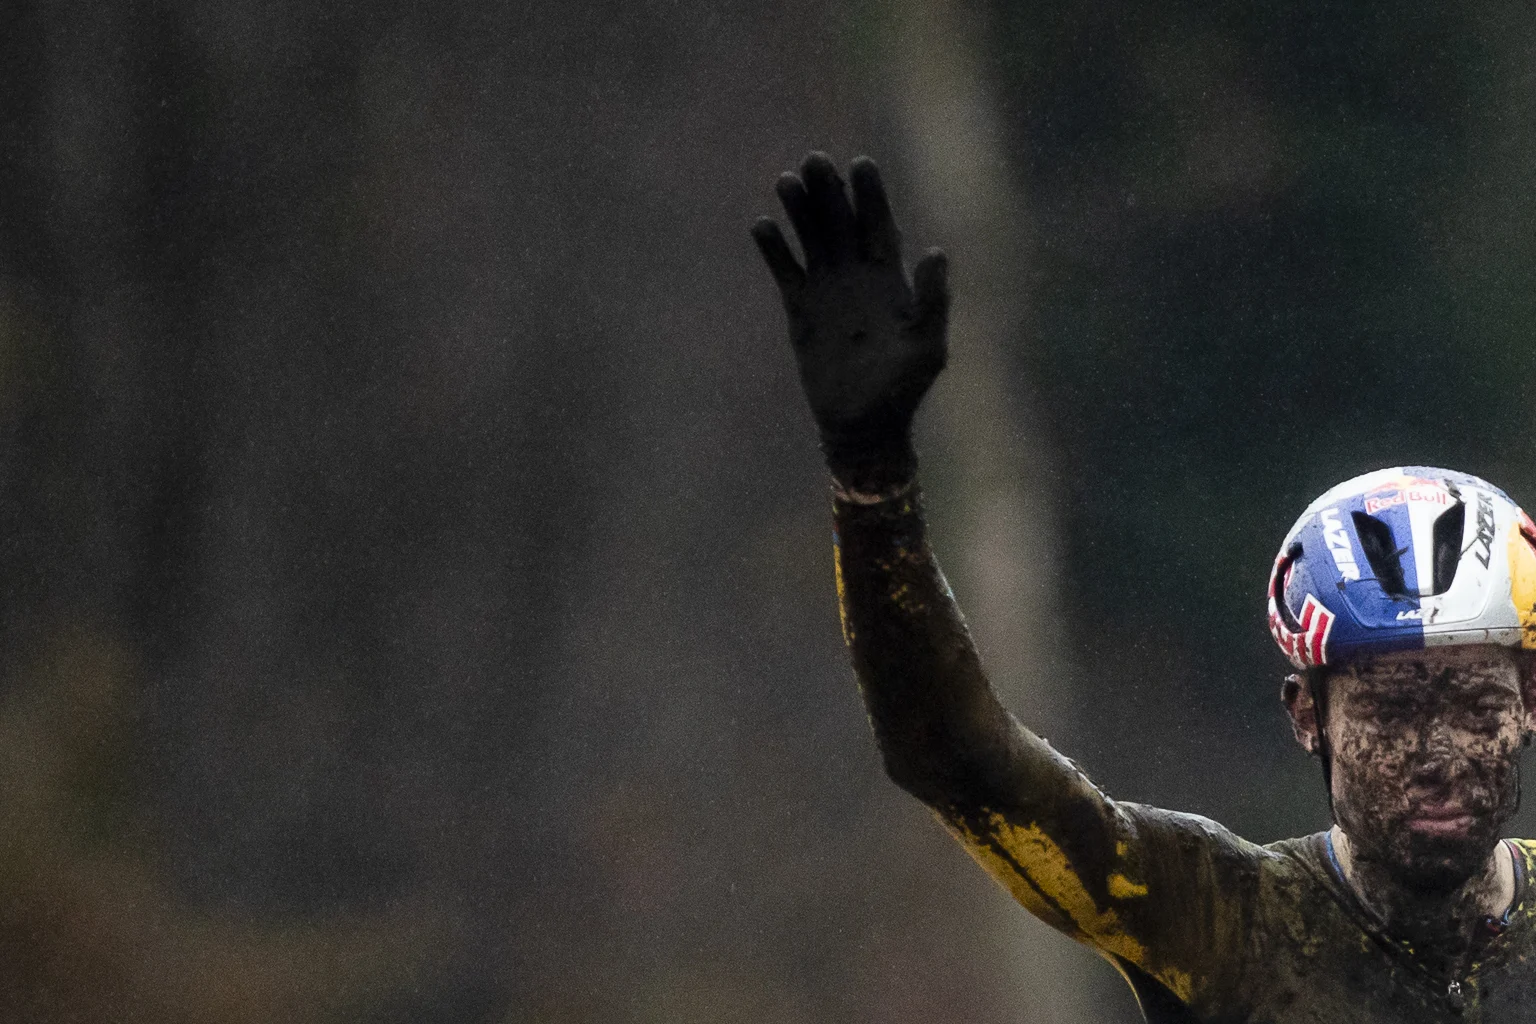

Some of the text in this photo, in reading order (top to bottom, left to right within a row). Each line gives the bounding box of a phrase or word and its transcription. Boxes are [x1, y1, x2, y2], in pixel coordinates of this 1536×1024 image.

[1366, 491, 1446, 513] Red Bull
[1475, 491, 1496, 571] LAZER
[1321, 507, 1360, 583] LAZER
